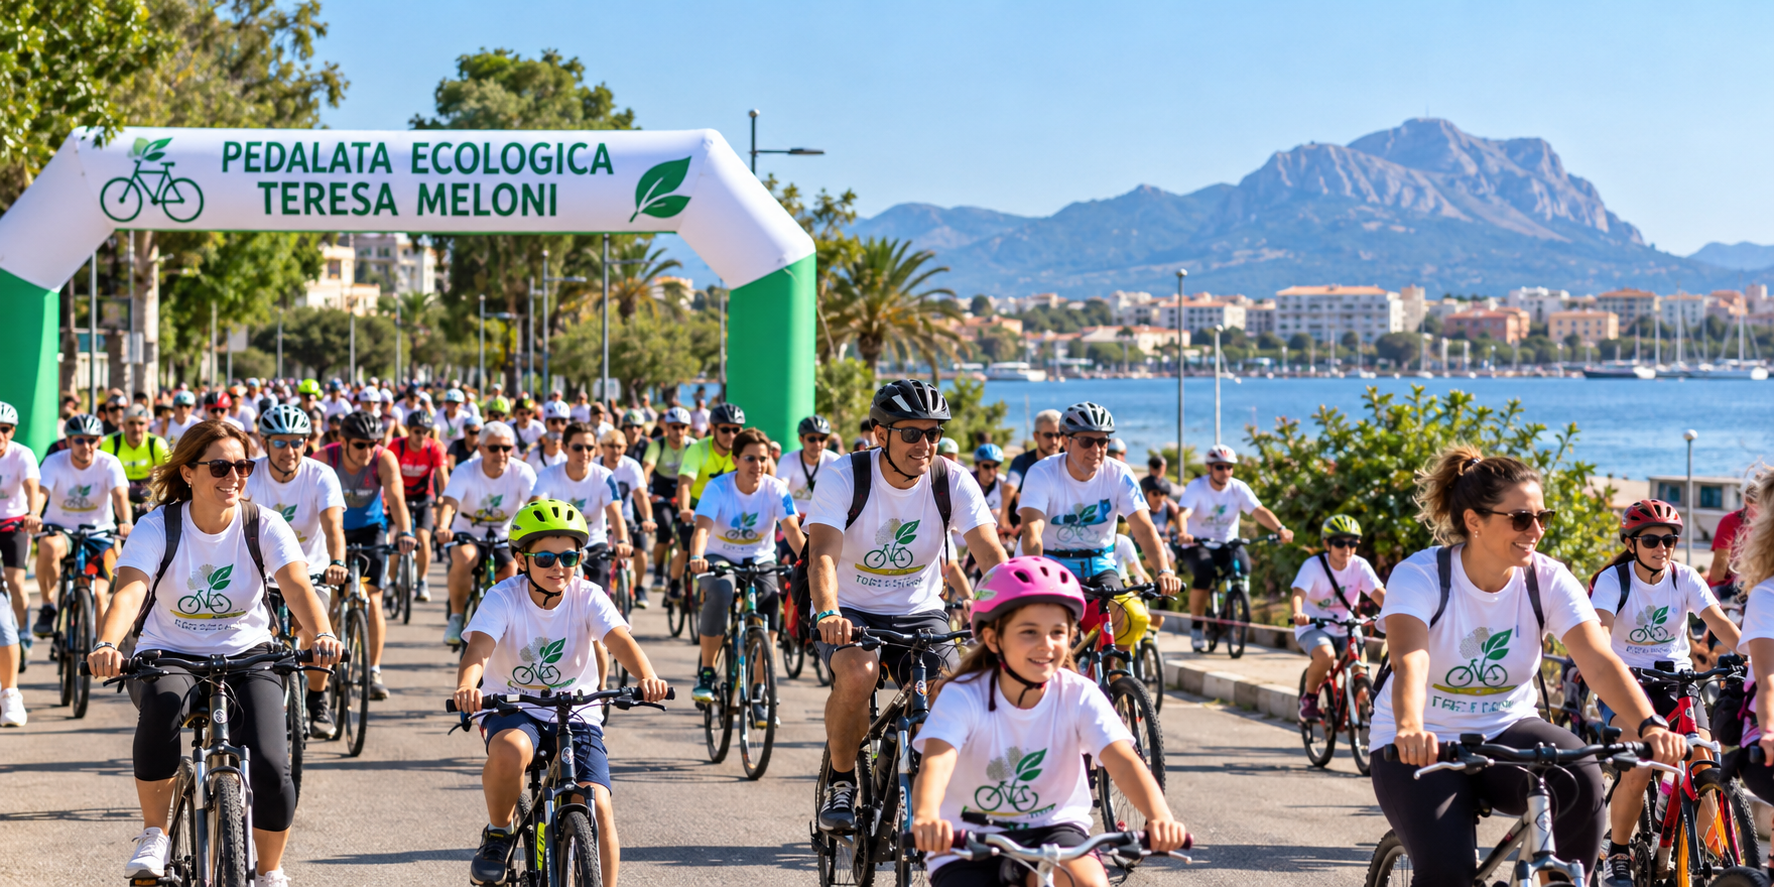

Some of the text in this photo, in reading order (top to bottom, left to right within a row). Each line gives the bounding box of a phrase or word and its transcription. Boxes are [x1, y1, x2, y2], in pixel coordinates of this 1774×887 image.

[222, 141, 614, 175] PEDALATA ECOLOGICA
[257, 181, 557, 217] TERESA MELONI
